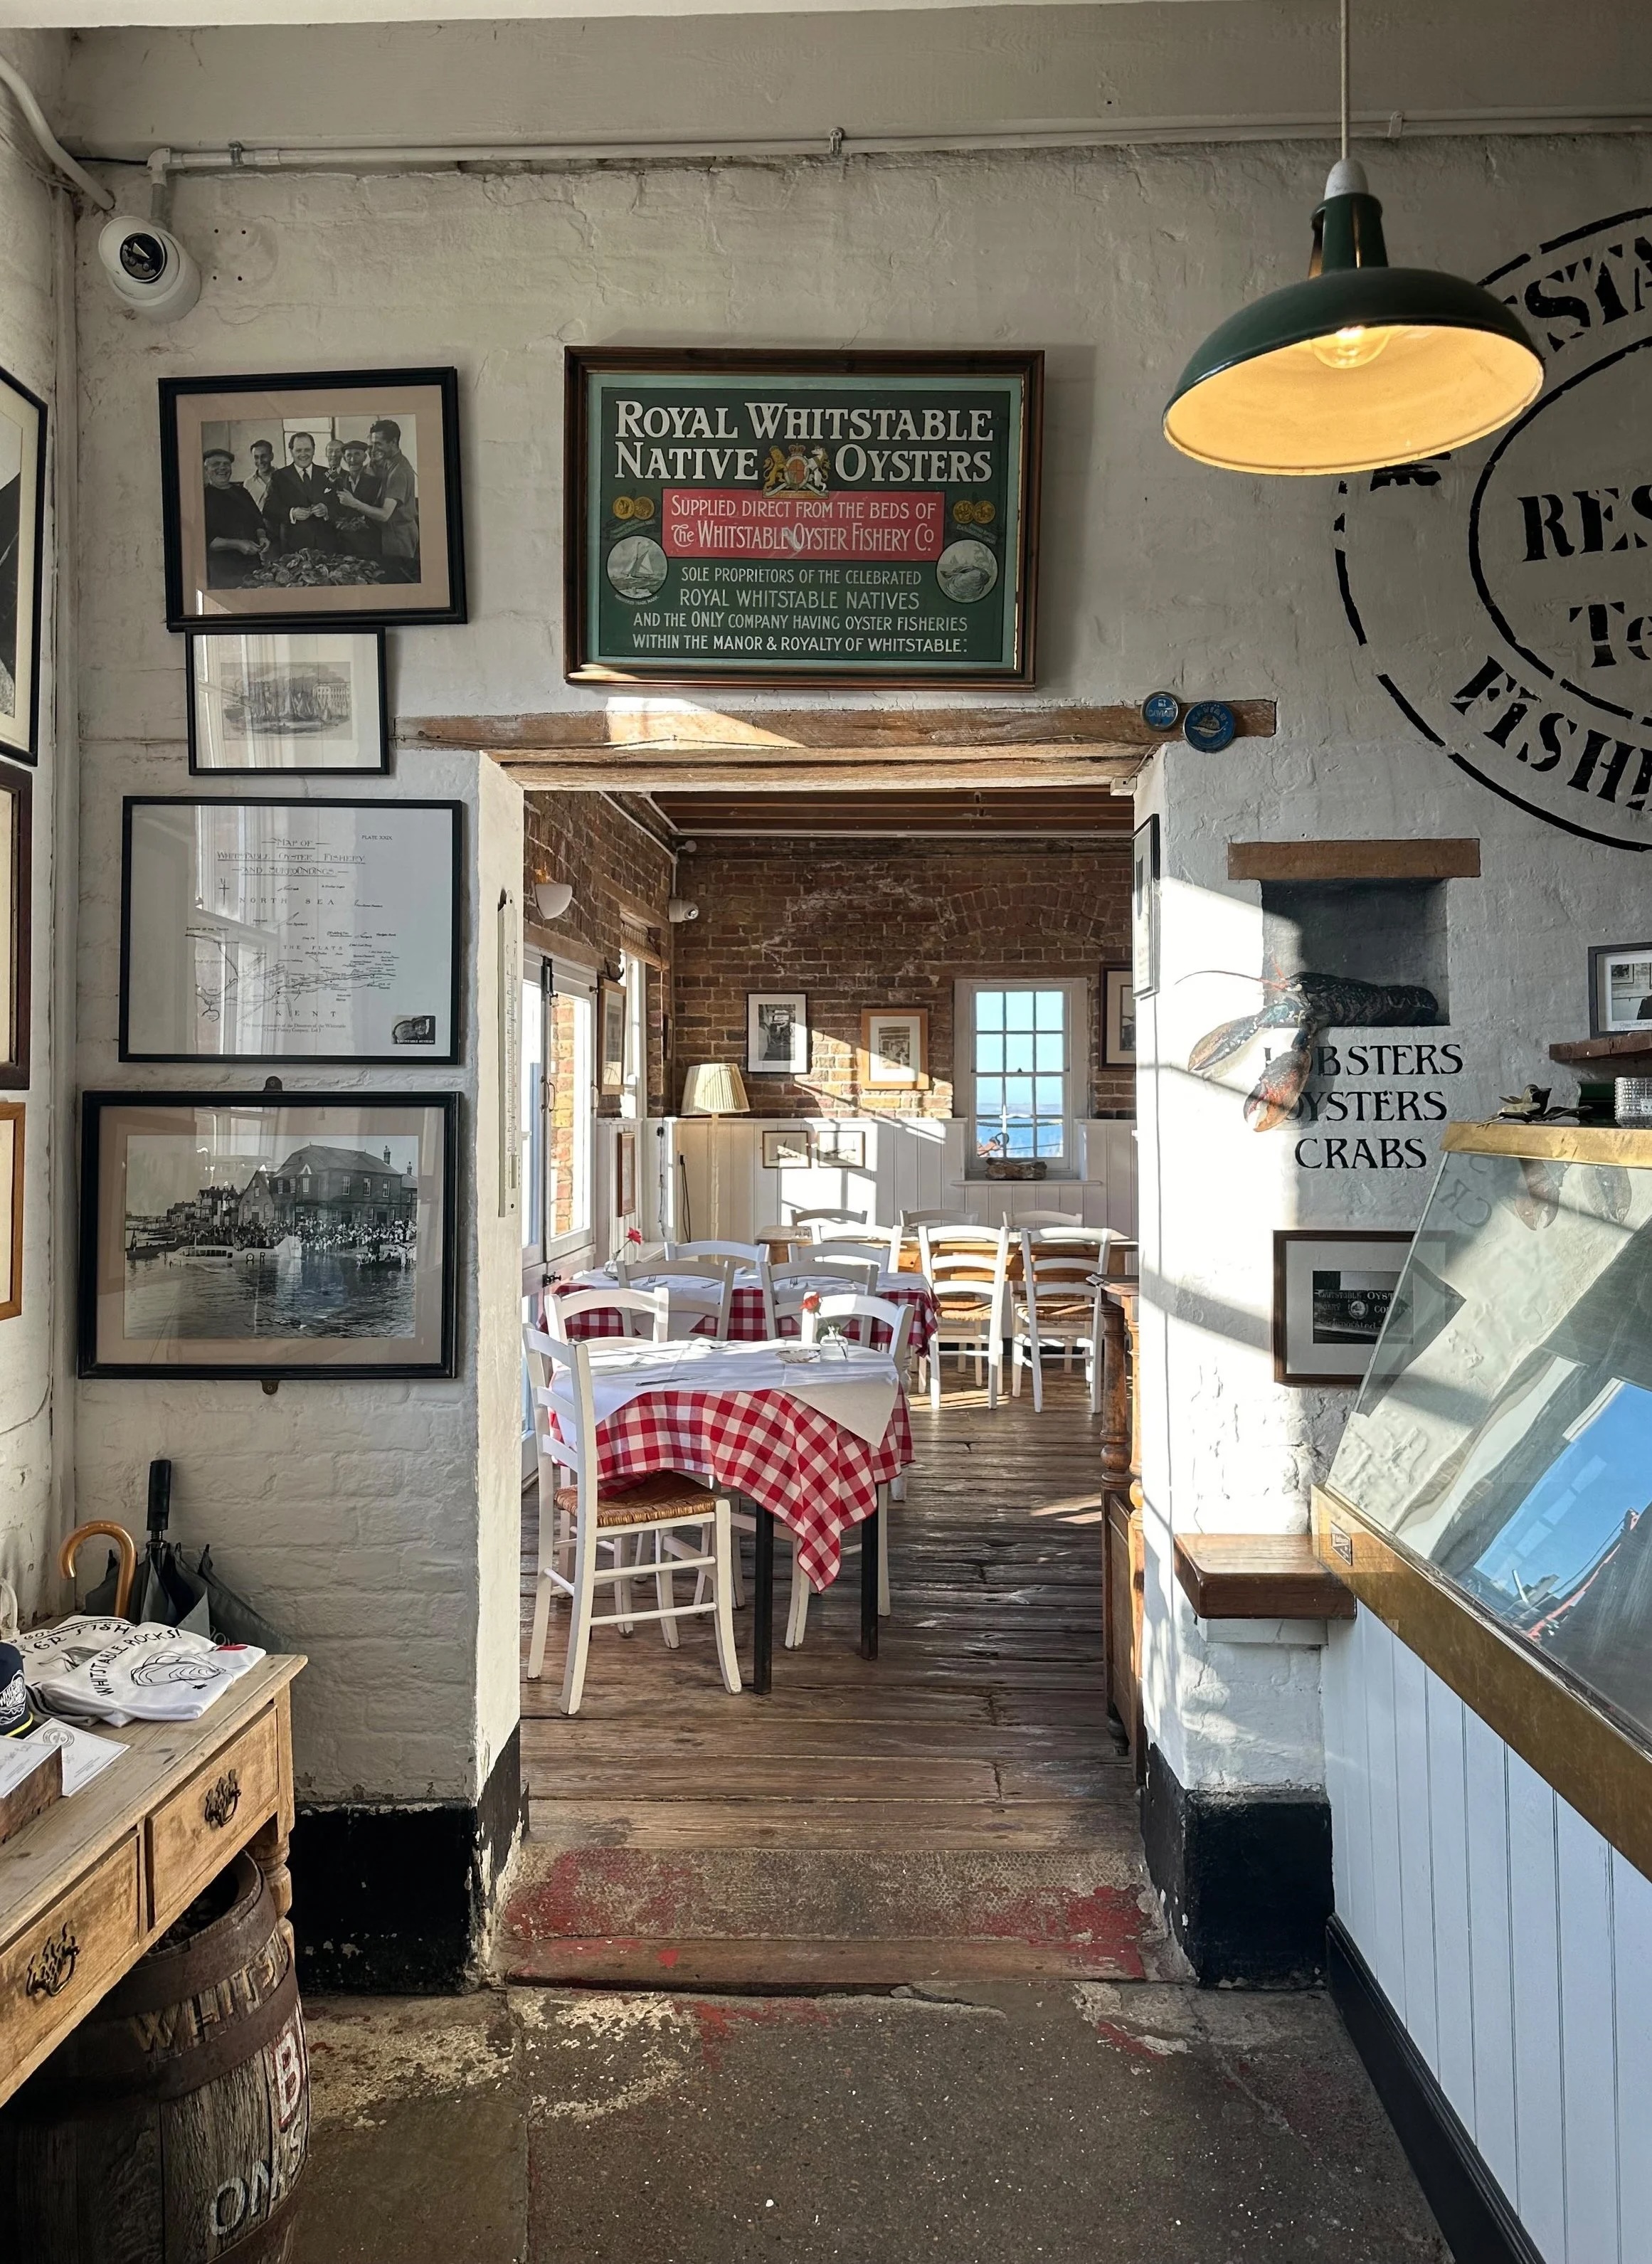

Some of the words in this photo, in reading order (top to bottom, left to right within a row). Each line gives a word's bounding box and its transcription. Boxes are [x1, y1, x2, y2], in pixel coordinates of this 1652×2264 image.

[615, 400, 738, 439] ROYAL
[744, 402, 993, 441] WHITSTABLE
[615, 440, 758, 480] NATIVE
[835, 443, 992, 482] OYSTERS
[671, 494, 736, 517] SUPPLIED
[741, 501, 791, 518] DIRECT
[795, 501, 833, 519] FROM
[837, 502, 865, 519] THE
[869, 502, 910, 519] BEDS
[915, 502, 937, 519] OF
[671, 524, 695, 548] The
[697, 520, 788, 550] WHITSTABLE
[793, 522, 849, 551] OYSTER
[852, 522, 912, 551] FISHERY
[681, 566, 710, 582] SOLE
[714, 567, 795, 583] PROPRIETORS
[798, 568, 816, 584] OF
[818, 569, 841, 584] THE
[845, 570, 922, 586] CELEBRATED
[680, 588, 730, 607] ROYAL
[736, 590, 839, 609] WHITSTABLE
[846, 591, 920, 610] NATIVES
[633, 612, 661, 627] AND
[663, 613, 687, 628] THE
[691, 610, 726, 628] ONLY
[727, 613, 789, 629] COMPANY
[793, 615, 841, 630] HAVING
[844, 615, 892, 632] OYSTER
[897, 616, 968, 633] FISHERIES
[632, 633, 679, 649] WITHIN
[683, 634, 709, 650] THE
[713, 635, 763, 651] MANOR
[766, 635, 778, 651] &
[780, 636, 843, 652] ROYALTY
[844, 637, 865, 652] OF
[1264, 1043, 1464, 1077] BSTERS
[1294, 1138, 1427, 1170] CRABS
